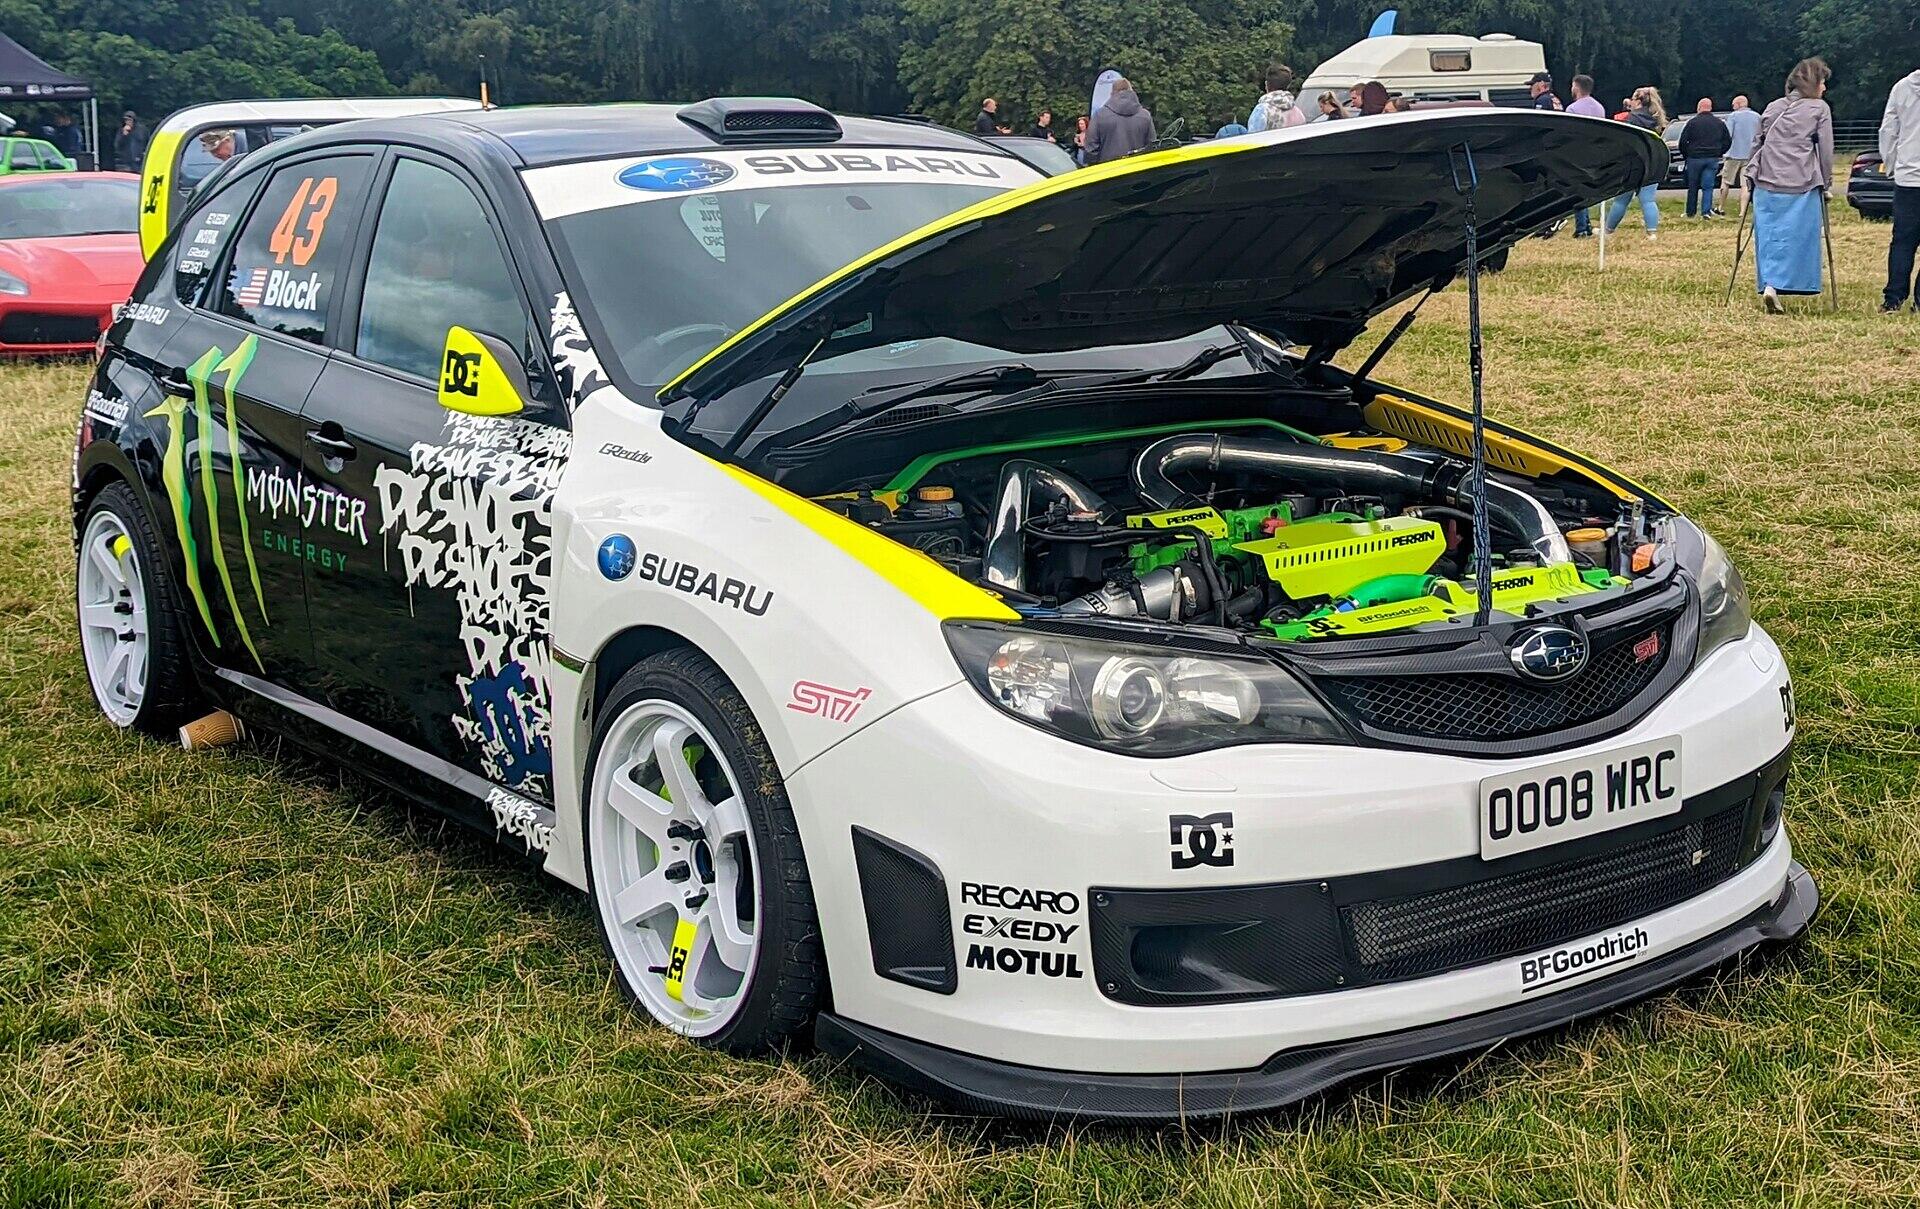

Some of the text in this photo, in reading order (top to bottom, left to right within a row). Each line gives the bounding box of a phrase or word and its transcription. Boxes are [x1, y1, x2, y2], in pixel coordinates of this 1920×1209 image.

[744, 154, 1001, 180] SUBARU
[269, 177, 338, 266] 43
[264, 270, 322, 311] Block
[125, 302, 171, 325] SUBARU
[598, 443, 653, 464] GReddy
[1166, 511, 1214, 525] PERRIN
[263, 530, 347, 572] ENERGY
[1392, 530, 1435, 547] PERRIN
[639, 553, 774, 617] SUBARU
[1490, 575, 1534, 592] PERRIN
[1357, 605, 1430, 623] BFGoodrich
[1606, 749, 1676, 814] WRC
[1169, 812, 1235, 870] DC
[961, 881, 1080, 915] RECARO
[962, 913, 1080, 944] EXEDY
[965, 944, 1083, 979] MOTUL
[1520, 927, 1648, 985] BFGoodrich
